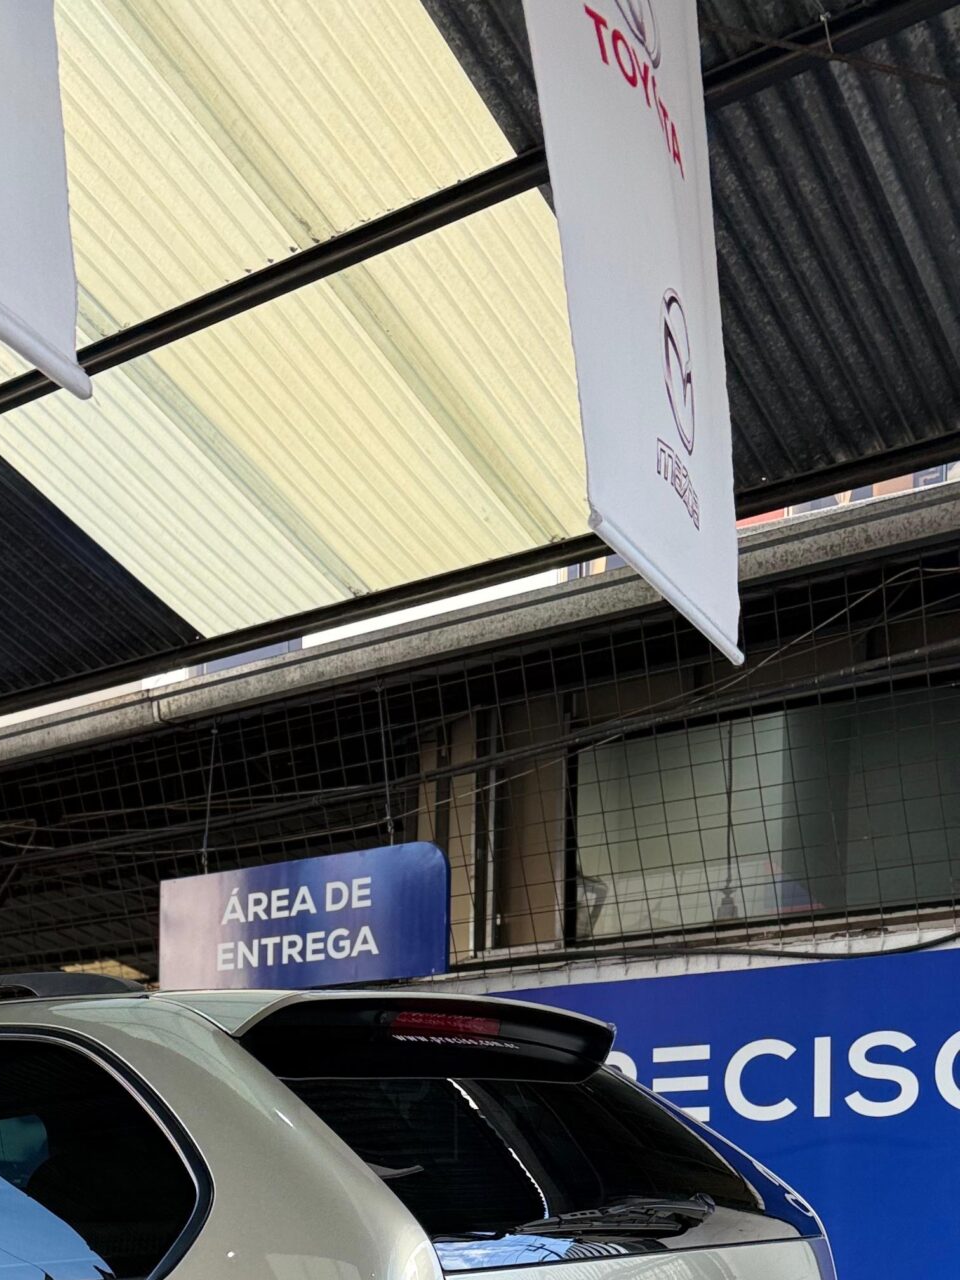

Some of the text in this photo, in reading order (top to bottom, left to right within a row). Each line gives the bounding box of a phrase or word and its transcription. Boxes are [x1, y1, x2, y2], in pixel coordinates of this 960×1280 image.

[584, 4, 684, 181] TOYTA
[221, 876, 372, 925] ÁREA DE
[216, 925, 380, 971] ENTREGA
